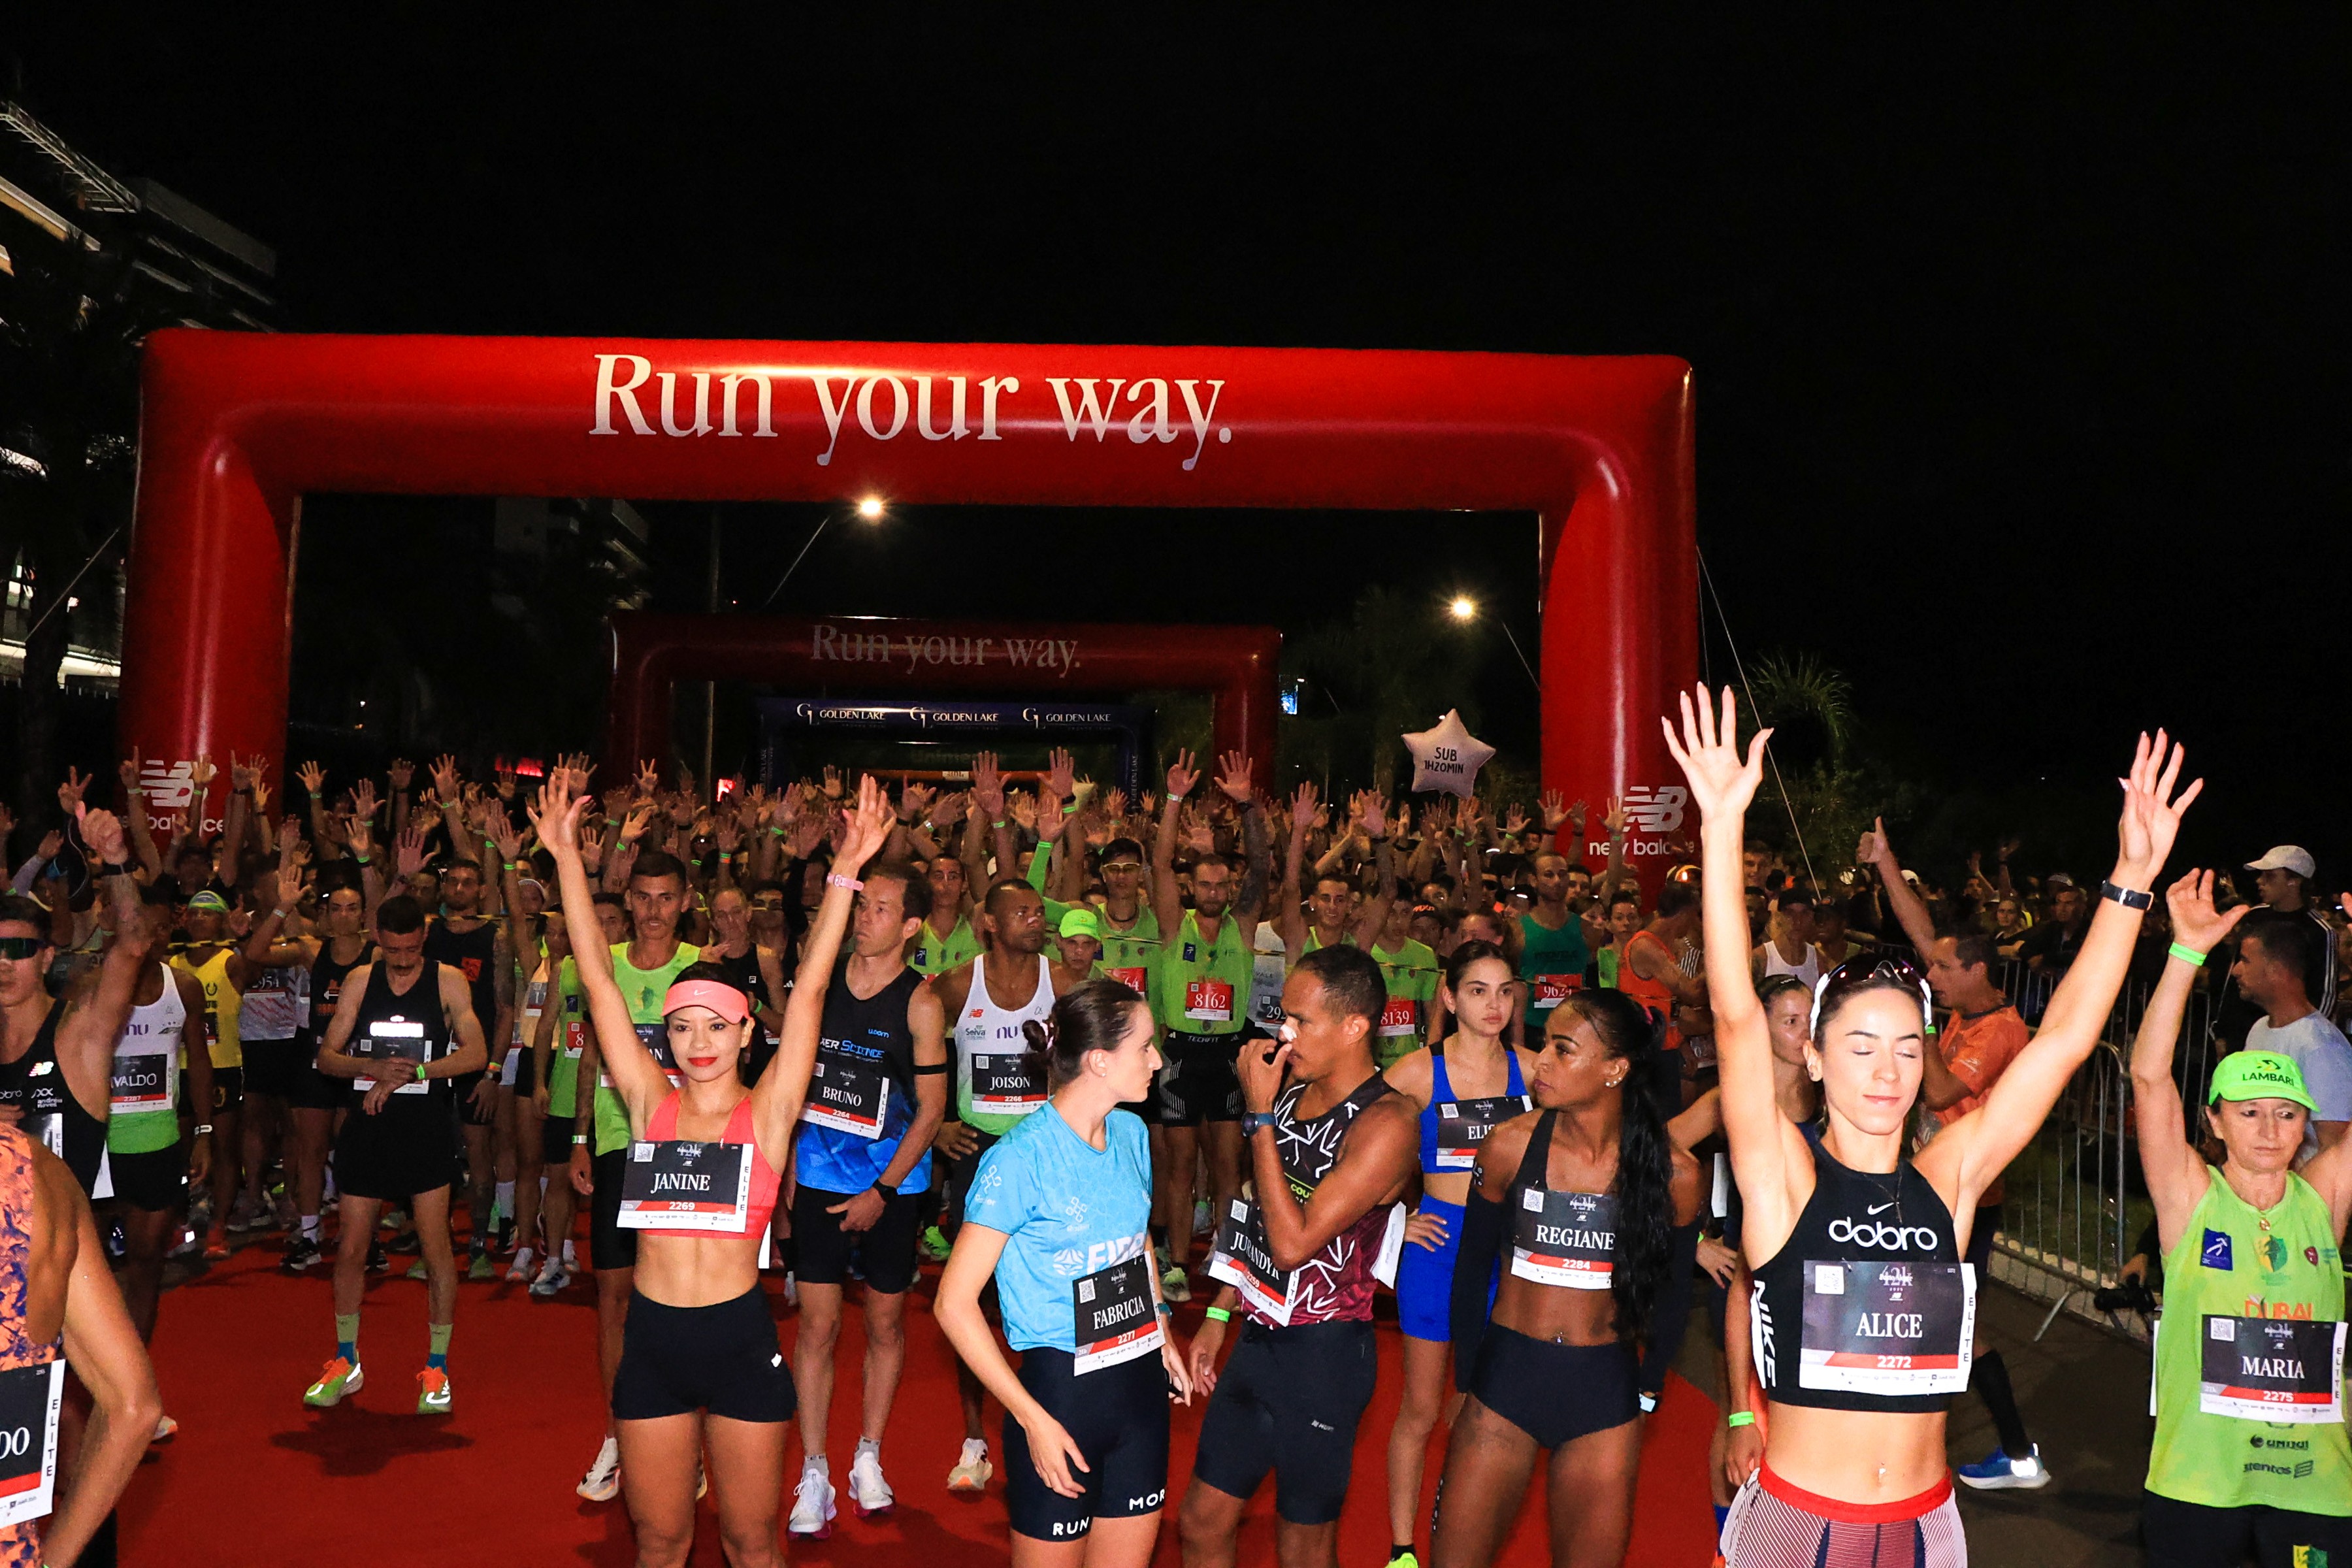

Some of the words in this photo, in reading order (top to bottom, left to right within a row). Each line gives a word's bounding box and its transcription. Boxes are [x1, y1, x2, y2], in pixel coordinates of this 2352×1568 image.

[588, 353, 778, 438] Run
[811, 374, 1019, 466] your
[1046, 376, 1232, 471] way.
[811, 625, 890, 662] Run
[905, 635, 992, 674] your
[1003, 638, 1082, 678] way.
[819, 710, 860, 719] GOLDEN
[861, 711, 886, 720] LAKE
[932, 713, 973, 722] GOLDEN
[974, 713, 999, 722] LAKE
[1045, 713, 1086, 722] GOLDEN
[1087, 713, 1111, 722] LAKE
[1434, 747, 1458, 762] SUB
[1424, 760, 1464, 774] 1H20MIN
[1194, 992, 1226, 1009] 8162
[1380, 1010, 1410, 1026] 8139
[989, 1077, 1030, 1090] JOISON
[2242, 1072, 2295, 1086] LAMBARI
[822, 1086, 862, 1107] BRUNO
[650, 1173, 711, 1194] JANINE
[740, 1166, 750, 1211] ELITE
[668, 1201, 695, 1211] 2269
[1535, 1224, 1616, 1250] REGIANE
[1829, 1216, 1938, 1250] dobro
[1562, 1258, 1592, 1271] 2284
[1093, 1296, 1146, 1330] FABRICIA
[1754, 1280, 1776, 1388] NIKE
[1855, 1313, 1923, 1338] ALICE
[1963, 1297, 1975, 1362] ELITE
[1117, 1330, 1135, 1345] 2277
[1877, 1356, 1912, 1368] 2272
[2242, 1356, 2305, 1379] MARIA
[2334, 1347, 2343, 1399] ELITE
[2263, 1392, 2294, 1402] 2275
[46, 1399, 59, 1477] ELITE
[1129, 1488, 1166, 1511] MOR
[1053, 1516, 1089, 1535] RUN
